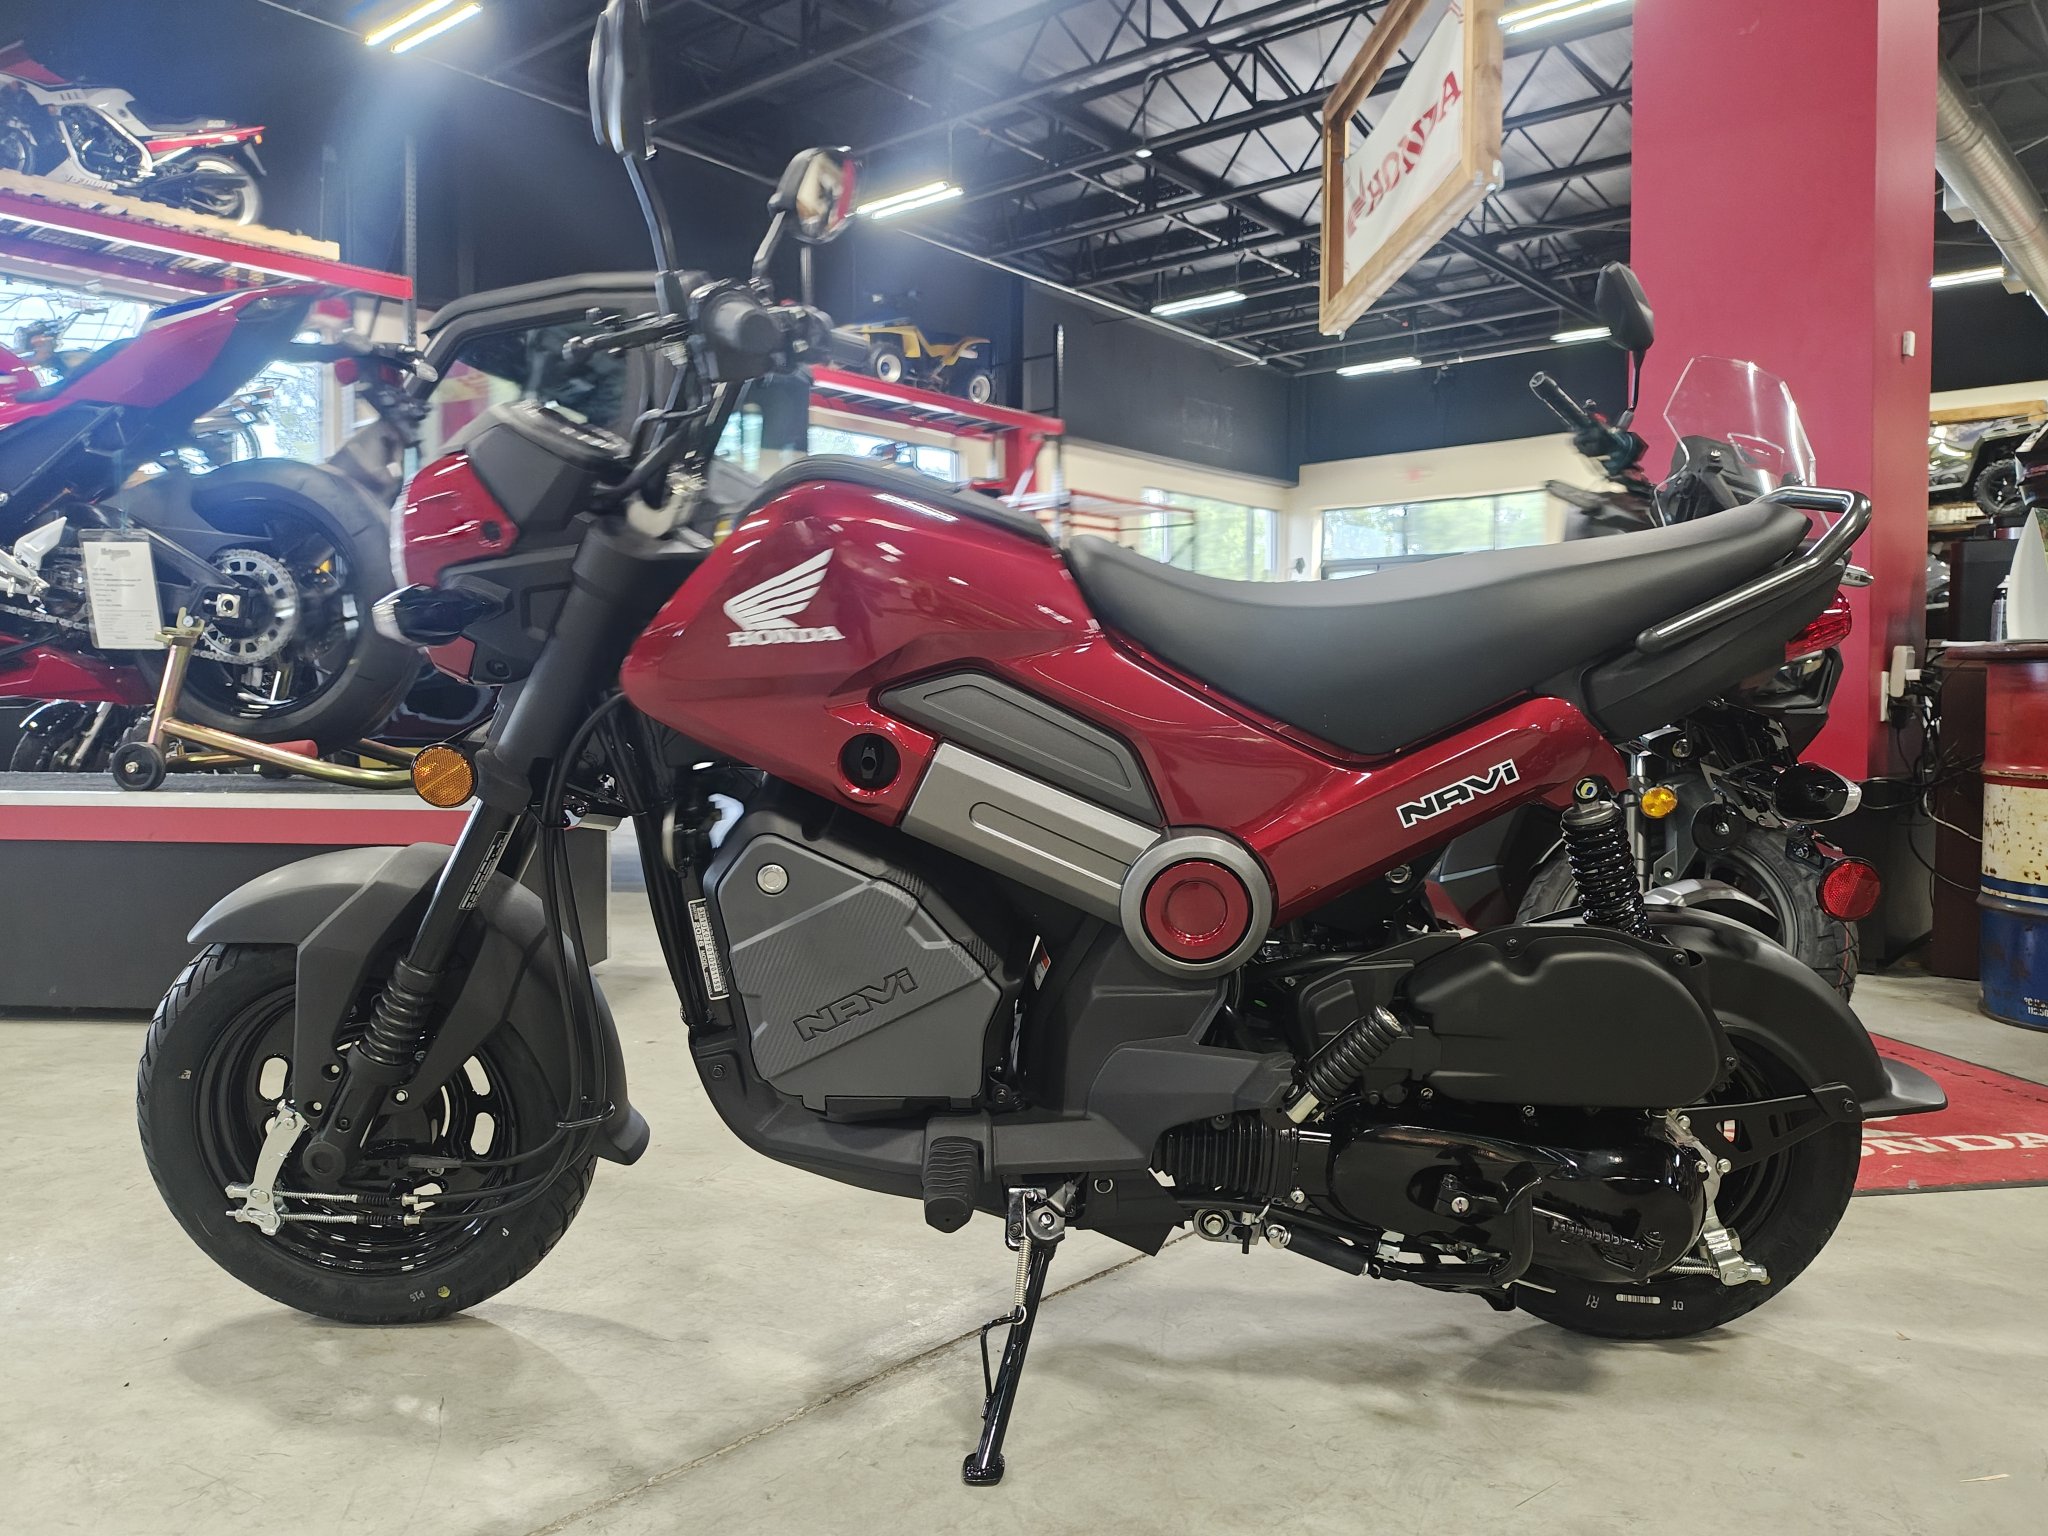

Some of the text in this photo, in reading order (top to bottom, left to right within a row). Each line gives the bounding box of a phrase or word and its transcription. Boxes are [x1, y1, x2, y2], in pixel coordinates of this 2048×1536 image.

[1366, 70, 1462, 217] HONDA
[726, 625, 846, 648] HONDA
[1861, 1132, 2048, 1157] NDA
